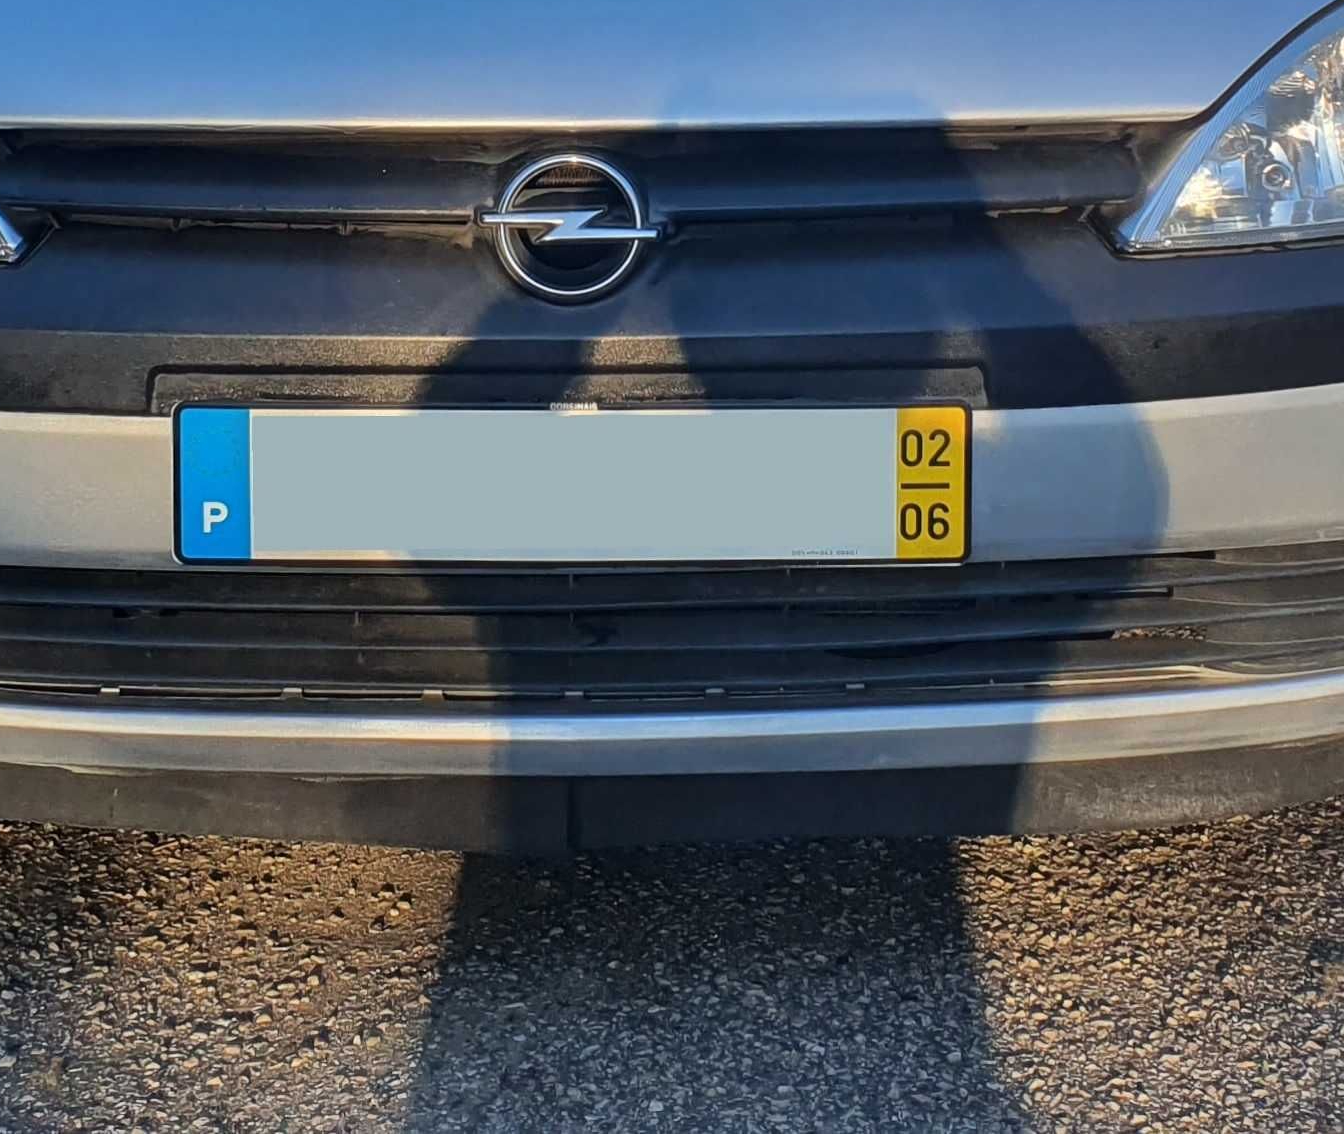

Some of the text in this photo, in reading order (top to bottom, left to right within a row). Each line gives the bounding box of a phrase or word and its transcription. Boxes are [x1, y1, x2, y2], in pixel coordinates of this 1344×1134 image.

[901, 429, 951, 467] 02
[203, 501, 229, 533] P
[900, 502, 950, 541] 06
